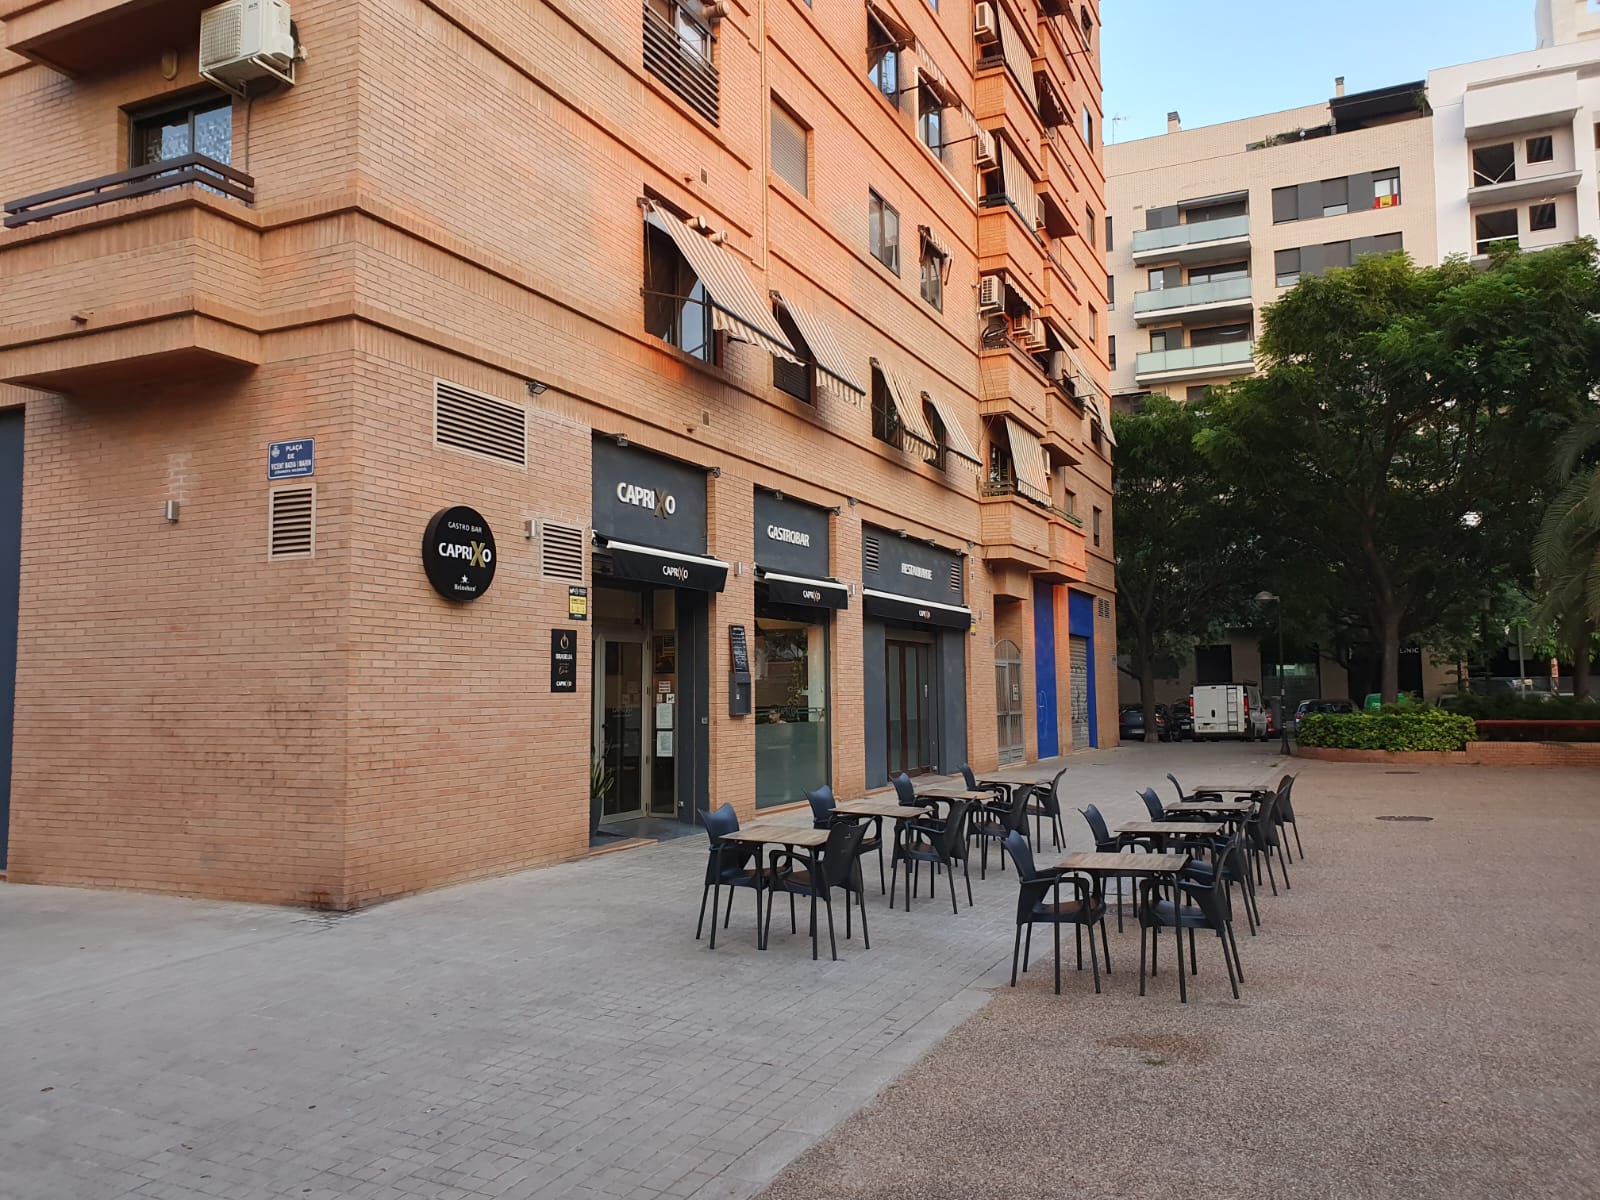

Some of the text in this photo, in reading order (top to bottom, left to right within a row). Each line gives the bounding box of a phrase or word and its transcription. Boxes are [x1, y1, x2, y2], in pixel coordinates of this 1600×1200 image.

[616, 482, 676, 519] CAPRIXO
[447, 521, 482, 533] GASTRO BAR
[767, 525, 810, 548] GASTROBAR
[438, 540, 492, 568] CAPRIXO
[662, 565, 689, 582] CAPRIXO
